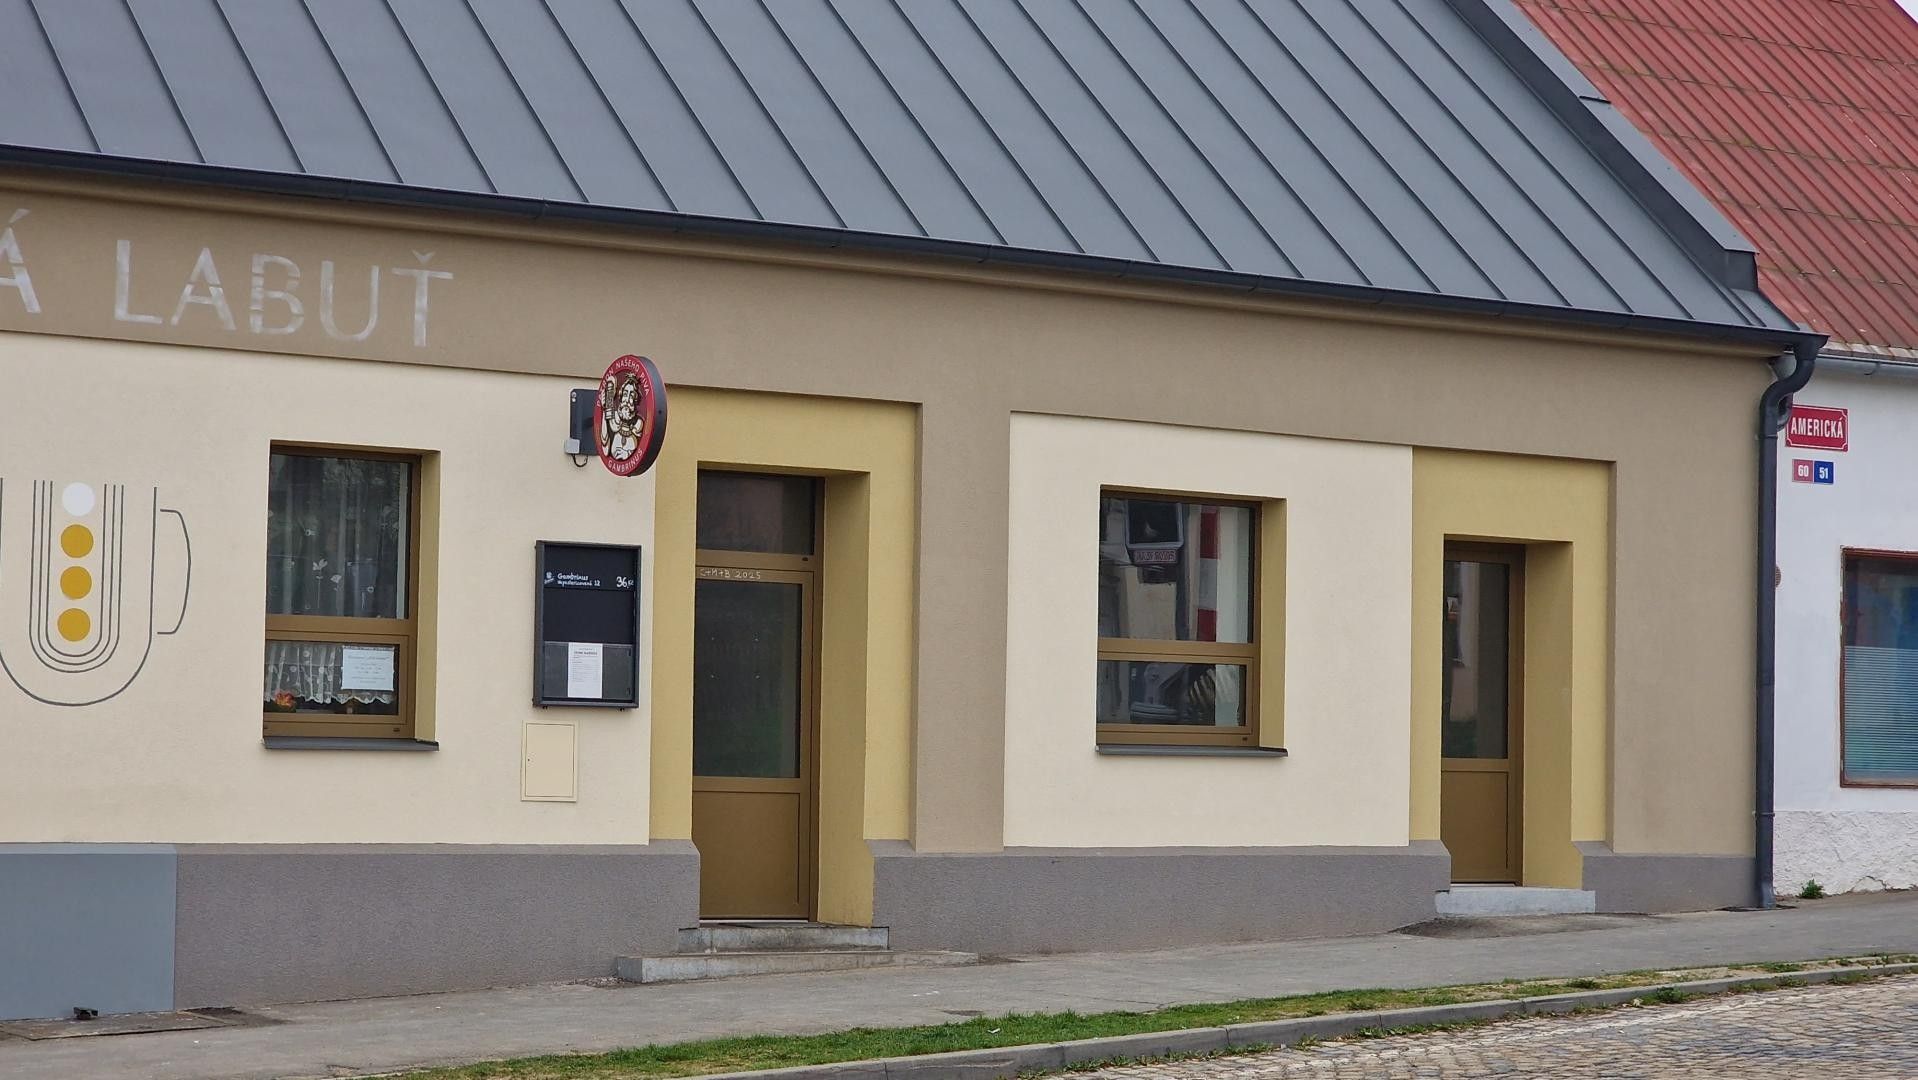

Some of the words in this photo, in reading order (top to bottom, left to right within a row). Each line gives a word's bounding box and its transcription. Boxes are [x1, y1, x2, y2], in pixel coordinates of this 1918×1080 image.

[114, 240, 454, 347] LABUŤ
[616, 358, 640, 372] NAŠEHO
[640, 372, 650, 397] PIVA
[1790, 416, 1844, 438] AMERICKÁ
[608, 448, 643, 472] GAMBRINUS
[1797, 464, 1809, 477] 60
[1819, 467, 1829, 479] 51
[594, 579, 601, 587] 12
[734, 570, 761, 580] 2025
